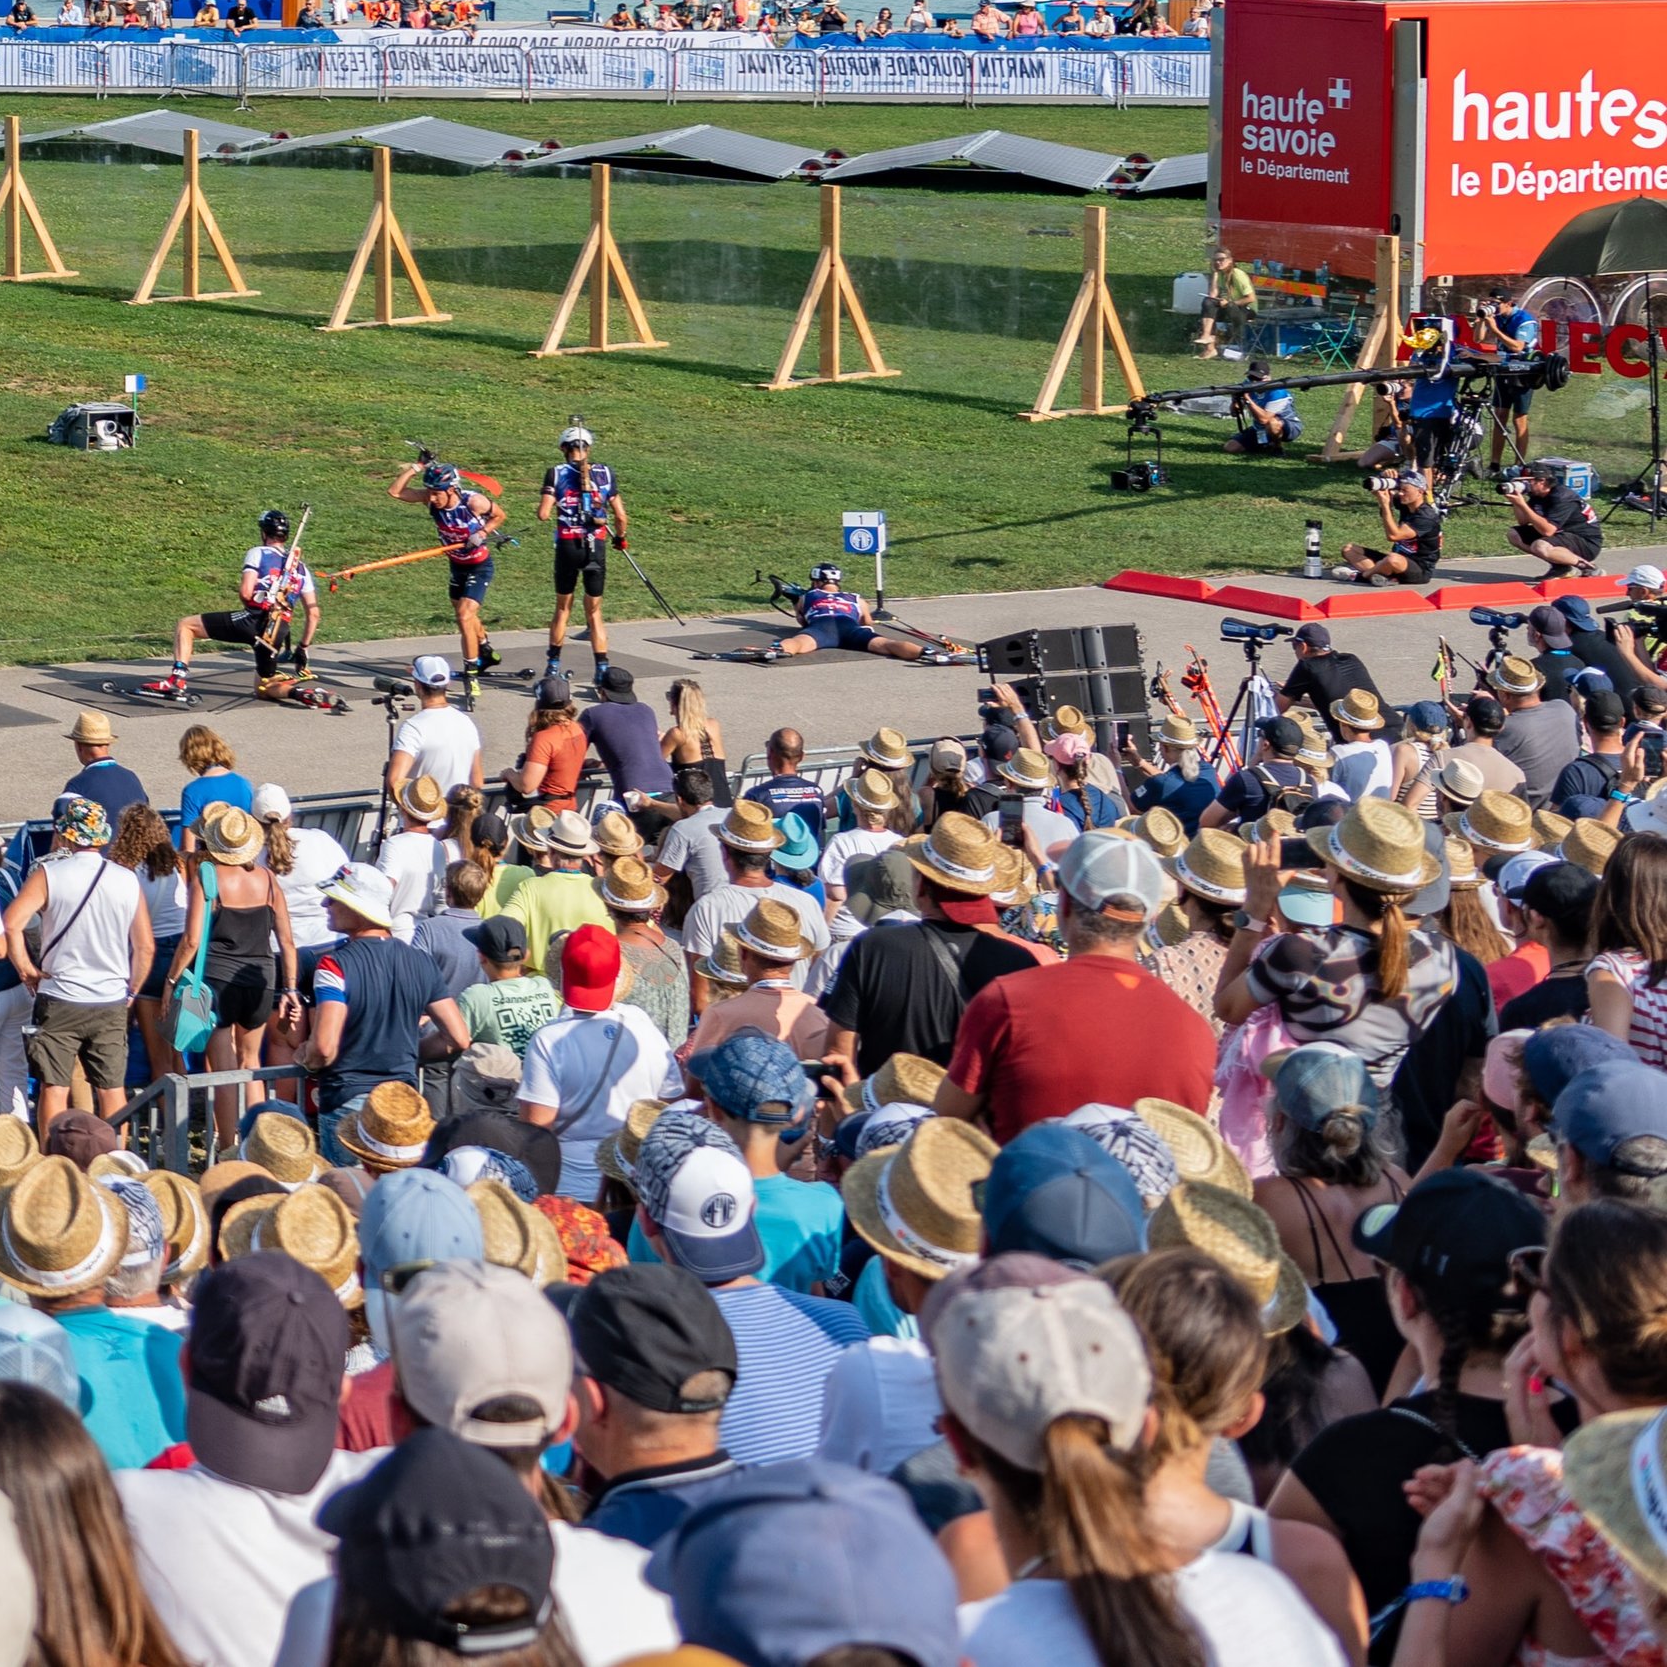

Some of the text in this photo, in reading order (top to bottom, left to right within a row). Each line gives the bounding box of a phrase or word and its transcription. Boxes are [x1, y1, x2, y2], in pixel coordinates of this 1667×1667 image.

[1241, 81, 1324, 124] haute
[1241, 124, 1336, 158] savoie
[1240, 157, 1350, 185] le Département
[1451, 163, 1480, 197] le
[859, 515, 864, 525] 1
